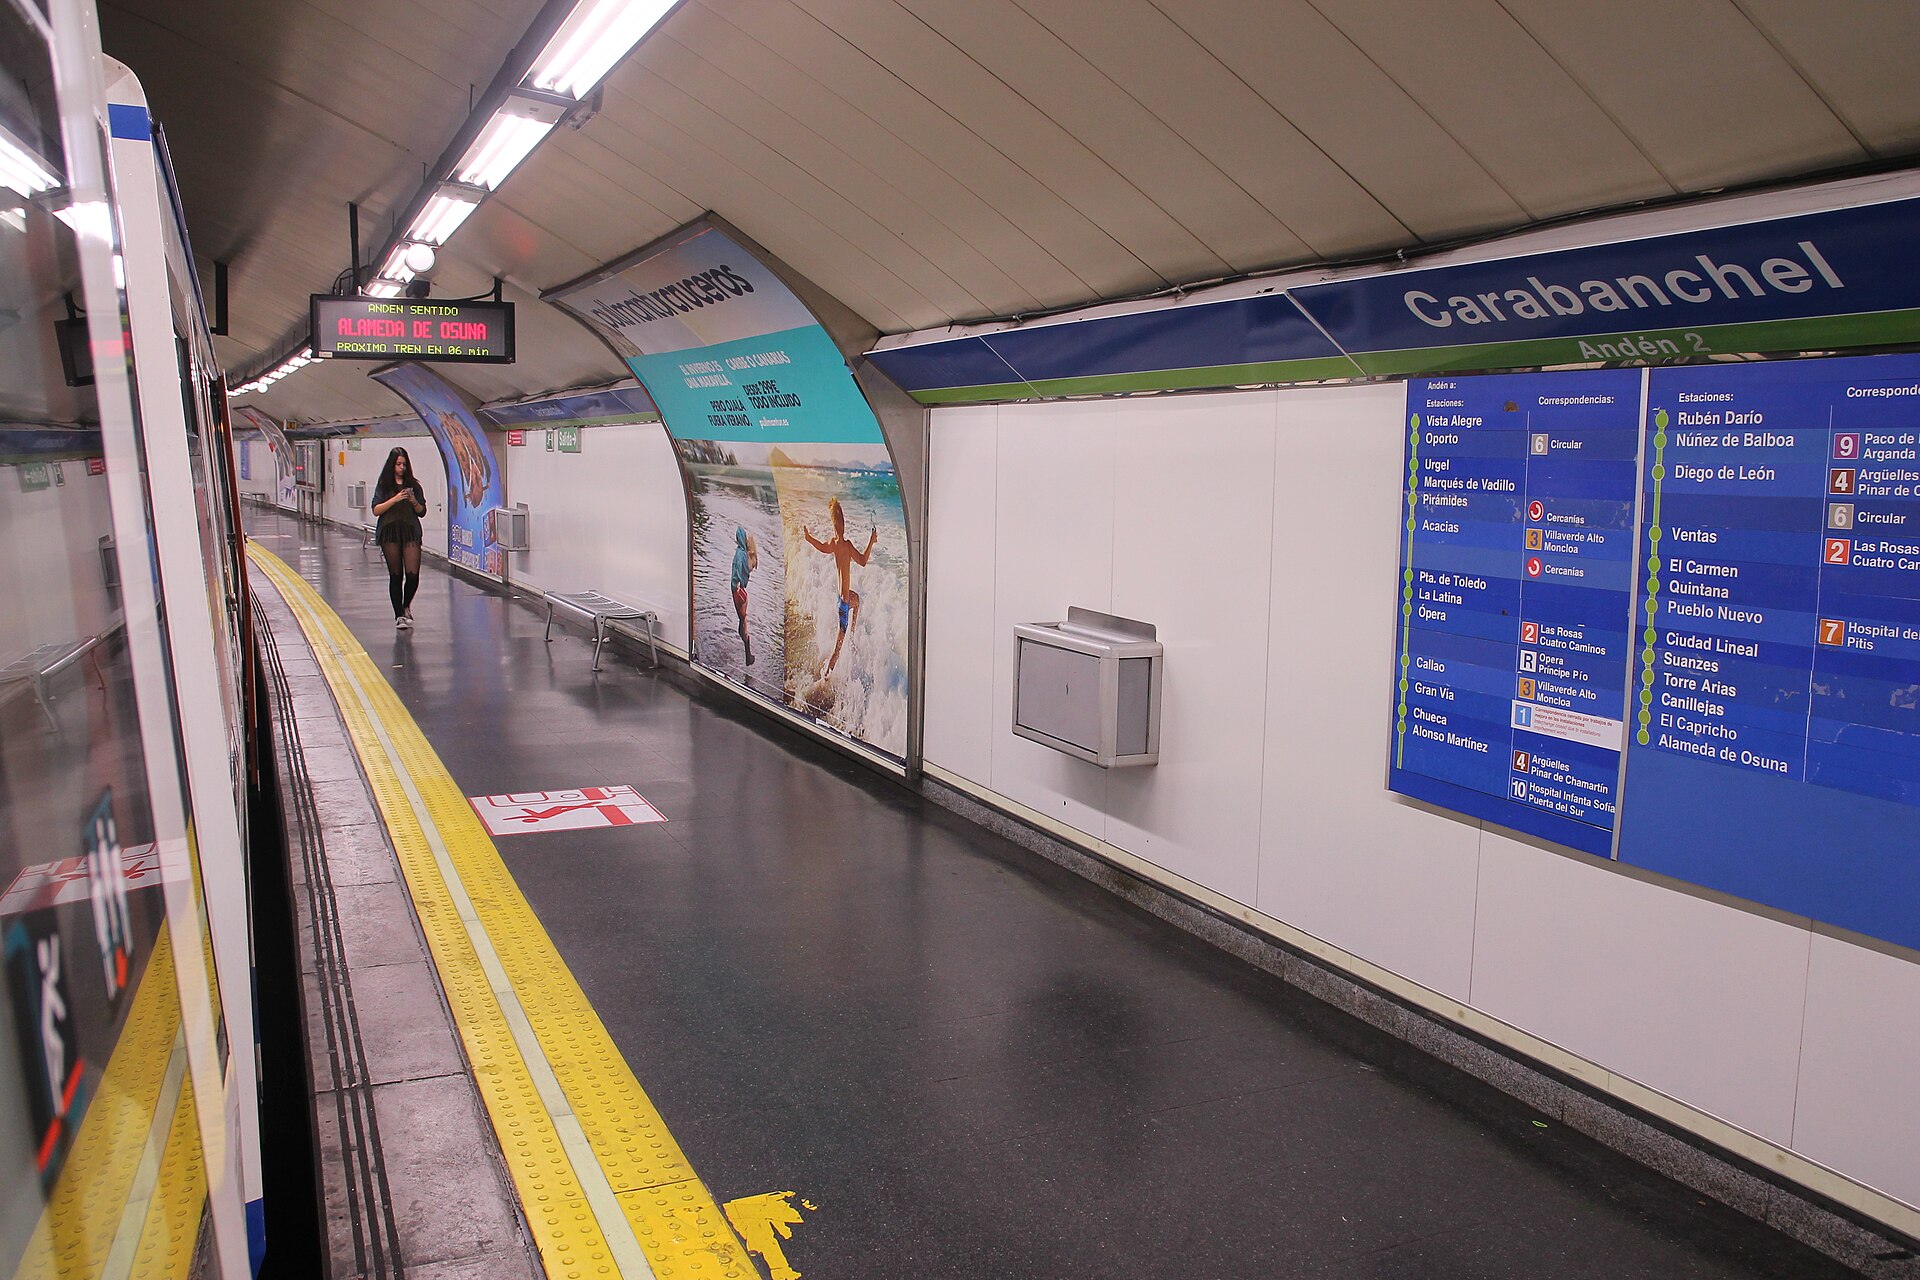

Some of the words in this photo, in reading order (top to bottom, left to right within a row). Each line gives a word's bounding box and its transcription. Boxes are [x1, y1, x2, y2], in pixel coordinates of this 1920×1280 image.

[1403, 241, 1845, 328] Carabanchel
[369, 304, 404, 314] ANDEN
[410, 306, 459, 316] SENTIDO
[338, 318, 405, 338] ALAMEDA
[413, 321, 432, 338] DE
[440, 322, 487, 340] OSUNA
[337, 342, 387, 352] PROXIMO
[394, 344, 421, 354] TREN
[428, 346, 441, 354] EN
[448, 347, 462, 355] 06
[469, 347, 489, 356] min
[1577, 334, 1682, 360] Andén
[1685, 333, 1712, 353] 2
[1428, 381, 1449, 390] Andén
[748, 395, 769, 409] TODO
[767, 392, 801, 408] INCLUIDO
[1427, 399, 1464, 408] Estaciones:
[1539, 395, 1614, 407] Correspondencias:
[1679, 392, 1734, 403] Estaciones:
[1427, 416, 1449, 427] Vista
[1451, 416, 1482, 428] Alegre
[1678, 412, 1720, 425] Rubén
[1725, 411, 1763, 425] Darío
[1426, 434, 1458, 446] Oporto
[1535, 437, 1544, 453] 6
[1551, 440, 1582, 450] Circular
[1676, 432, 1718, 447] Núñez
[1722, 433, 1739, 446] de
[1744, 433, 1794, 447] Balboa
[1840, 437, 1853, 457] 9
[1865, 434, 1894, 445] Paco
[1899, 433, 1915, 444] de
[1864, 448, 1915, 461] Arganda
[1425, 460, 1450, 472] Urgel
[1675, 466, 1713, 482] Diego
[1718, 466, 1735, 480] de
[1739, 466, 1775, 481] León
[1835, 472, 1848, 491] 4
[1859, 469, 1919, 483] Argüelles
[1424, 477, 1464, 490] Marqués
[1467, 479, 1478, 489] de
[1482, 479, 1515, 492] Vadillo
[1858, 485, 1891, 496] Pinar
[1894, 485, 1910, 496] de
[1423, 494, 1468, 507] Pirámides
[1547, 513, 1585, 524] Cercanías
[1834, 506, 1847, 527] 6
[1858, 512, 1906, 525] Circular
[1422, 520, 1459, 533] Acacias
[1530, 531, 1538, 547] 3
[1545, 530, 1585, 543] Villaverde
[1587, 534, 1605, 544] Alto
[1672, 528, 1717, 543] Ventas
[1544, 543, 1579, 554] Moncloa
[1830, 542, 1844, 561] 2
[1854, 540, 1876, 552] Las
[1880, 542, 1920, 555] Rosas
[1670, 559, 1683, 572] El
[1686, 560, 1738, 578] Carmen
[1853, 555, 1896, 569] Cuatro
[1545, 565, 1584, 577] Cercanías
[1420, 572, 1436, 583] Pta.
[1439, 574, 1450, 585] de
[1453, 575, 1487, 590] Toledo
[1419, 589, 1431, 600] La
[1433, 590, 1462, 605] Latina
[1669, 580, 1729, 599] Quintana
[1419, 606, 1446, 622] Ópera
[1668, 600, 1714, 619] Pueblo
[1718, 606, 1763, 624] Nuevo
[1525, 625, 1534, 641] 2
[1541, 625, 1555, 635] Las
[1557, 627, 1583, 640] Rosas
[1826, 623, 1839, 642] 7
[1848, 622, 1899, 639] Hospital
[1540, 637, 1566, 648] Cuatro
[1569, 640, 1606, 655] Caminos
[1666, 632, 1712, 651] Ciudad
[1716, 639, 1758, 658] Lineal
[1847, 637, 1874, 651] Pitis
[1417, 657, 1445, 672] Callao
[1523, 654, 1533, 670] R
[1539, 654, 1564, 666] Opera
[1664, 652, 1719, 673] Suanzes
[1539, 665, 1570, 680] Príncipe
[1573, 670, 1588, 681] Pío
[1415, 683, 1437, 697] Gran
[1440, 688, 1455, 701] Vía
[1523, 681, 1531, 696] 3
[1538, 681, 1578, 697] Villaverde
[1580, 688, 1596, 700] Alto
[1664, 673, 1697, 690] Torre
[1701, 679, 1737, 697] Arias
[1537, 693, 1571, 707] Moncloa
[1661, 693, 1724, 717] Canillejas
[1413, 708, 1447, 726] Chueca
[1520, 708, 1526, 723] 1
[1661, 714, 1673, 728] El
[1677, 717, 1737, 741] Capricho
[1413, 726, 1444, 742] Alonso
[1447, 733, 1488, 753] Martínez
[1517, 754, 1526, 769] 4
[1659, 734, 1716, 758] Alameda
[1720, 747, 1737, 762] de
[1741, 751, 1789, 773] Osuna
[1532, 755, 1570, 772] Argüelles
[1531, 765, 1551, 780] Pinar
[1553, 772, 1563, 782] de
[1566, 775, 1608, 794] Chamartín
[1512, 781, 1526, 797] 10
[1529, 783, 1561, 799] Hospital
[1563, 790, 1591, 807] Infanta
[1594, 799, 1615, 814] Sofía
[1529, 795, 1554, 810] Puerta
[1556, 800, 1568, 813] del
[1570, 804, 1584, 817] Sur
